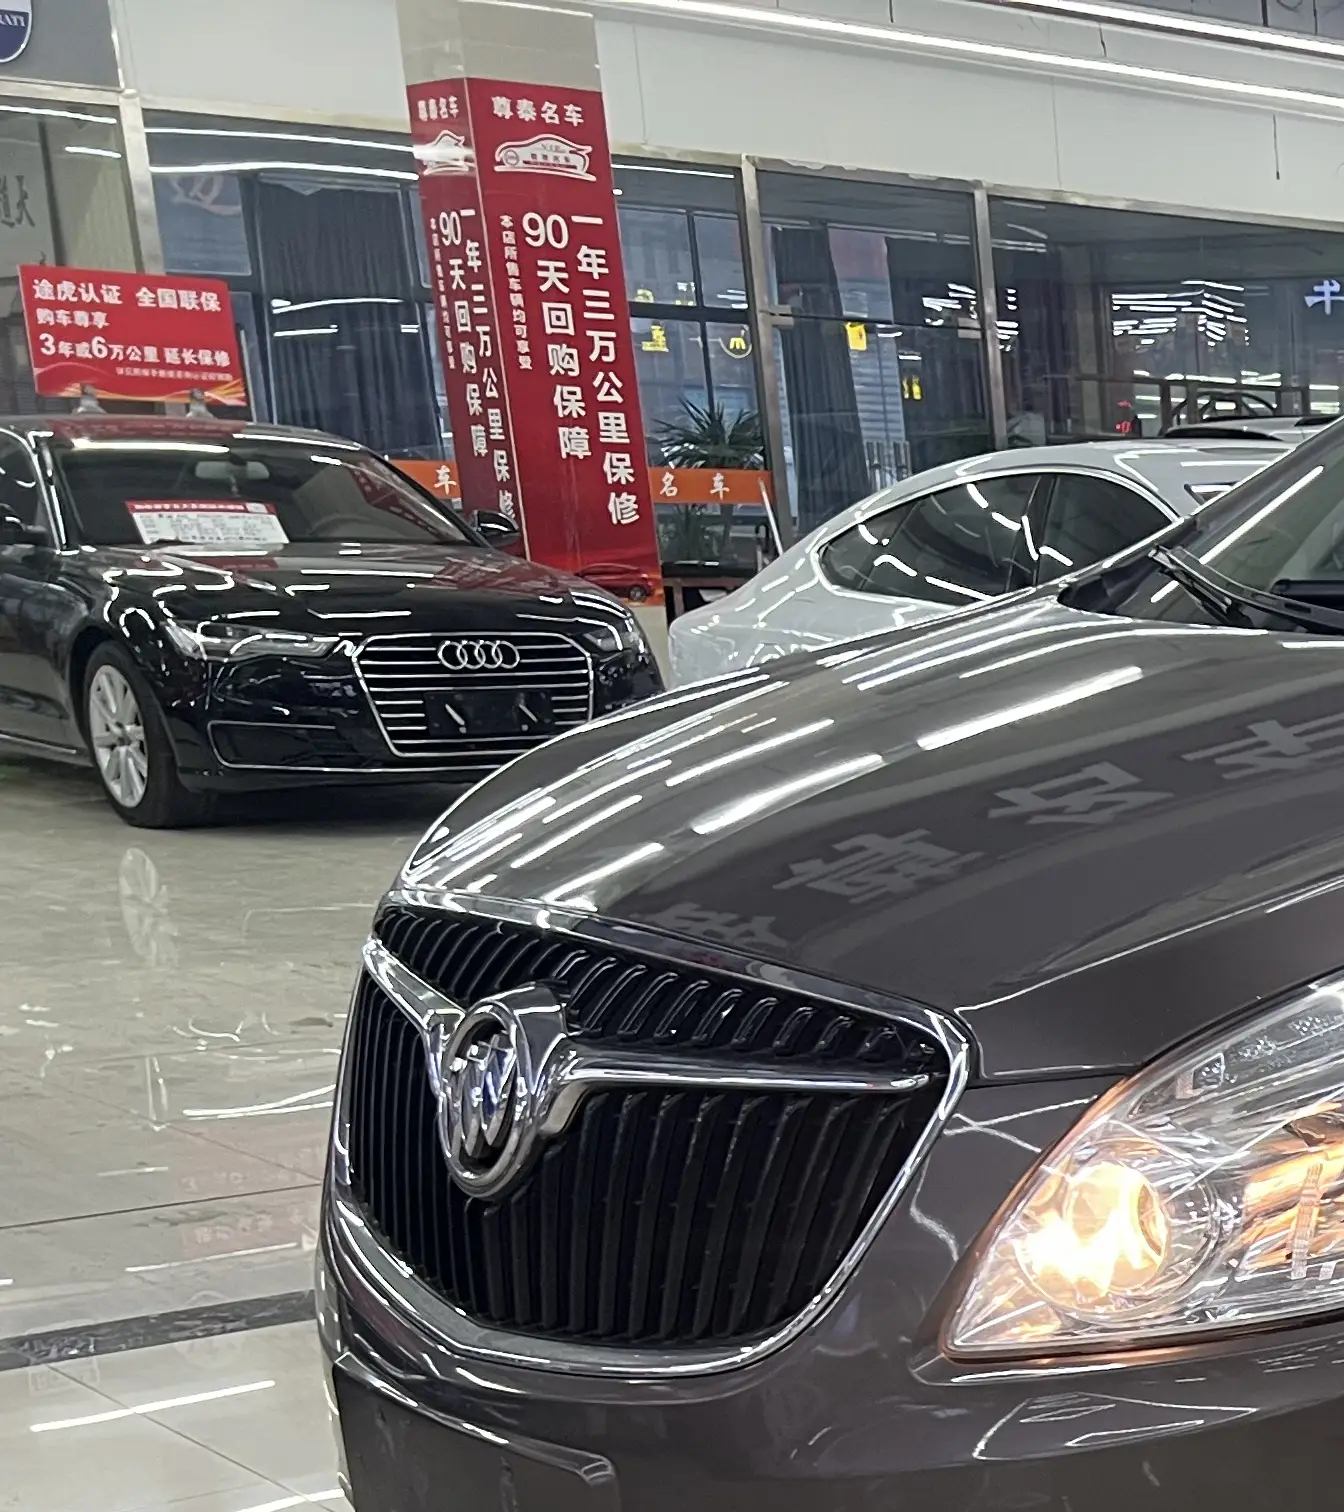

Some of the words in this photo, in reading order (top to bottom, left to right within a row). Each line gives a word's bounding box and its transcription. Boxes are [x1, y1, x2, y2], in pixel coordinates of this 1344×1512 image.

[33, 279, 123, 305] 途虎认证
[136, 286, 221, 312] 全国联保
[36, 308, 110, 329] 购车尊享
[39, 333, 159, 363] 3年或6万公里
[439, 211, 489, 457] 90天回购保障
[522, 212, 592, 459] 90天回购保障
[164, 348, 230, 368] 延长保修
[571, 215, 640, 525] 一年三万公里保修
